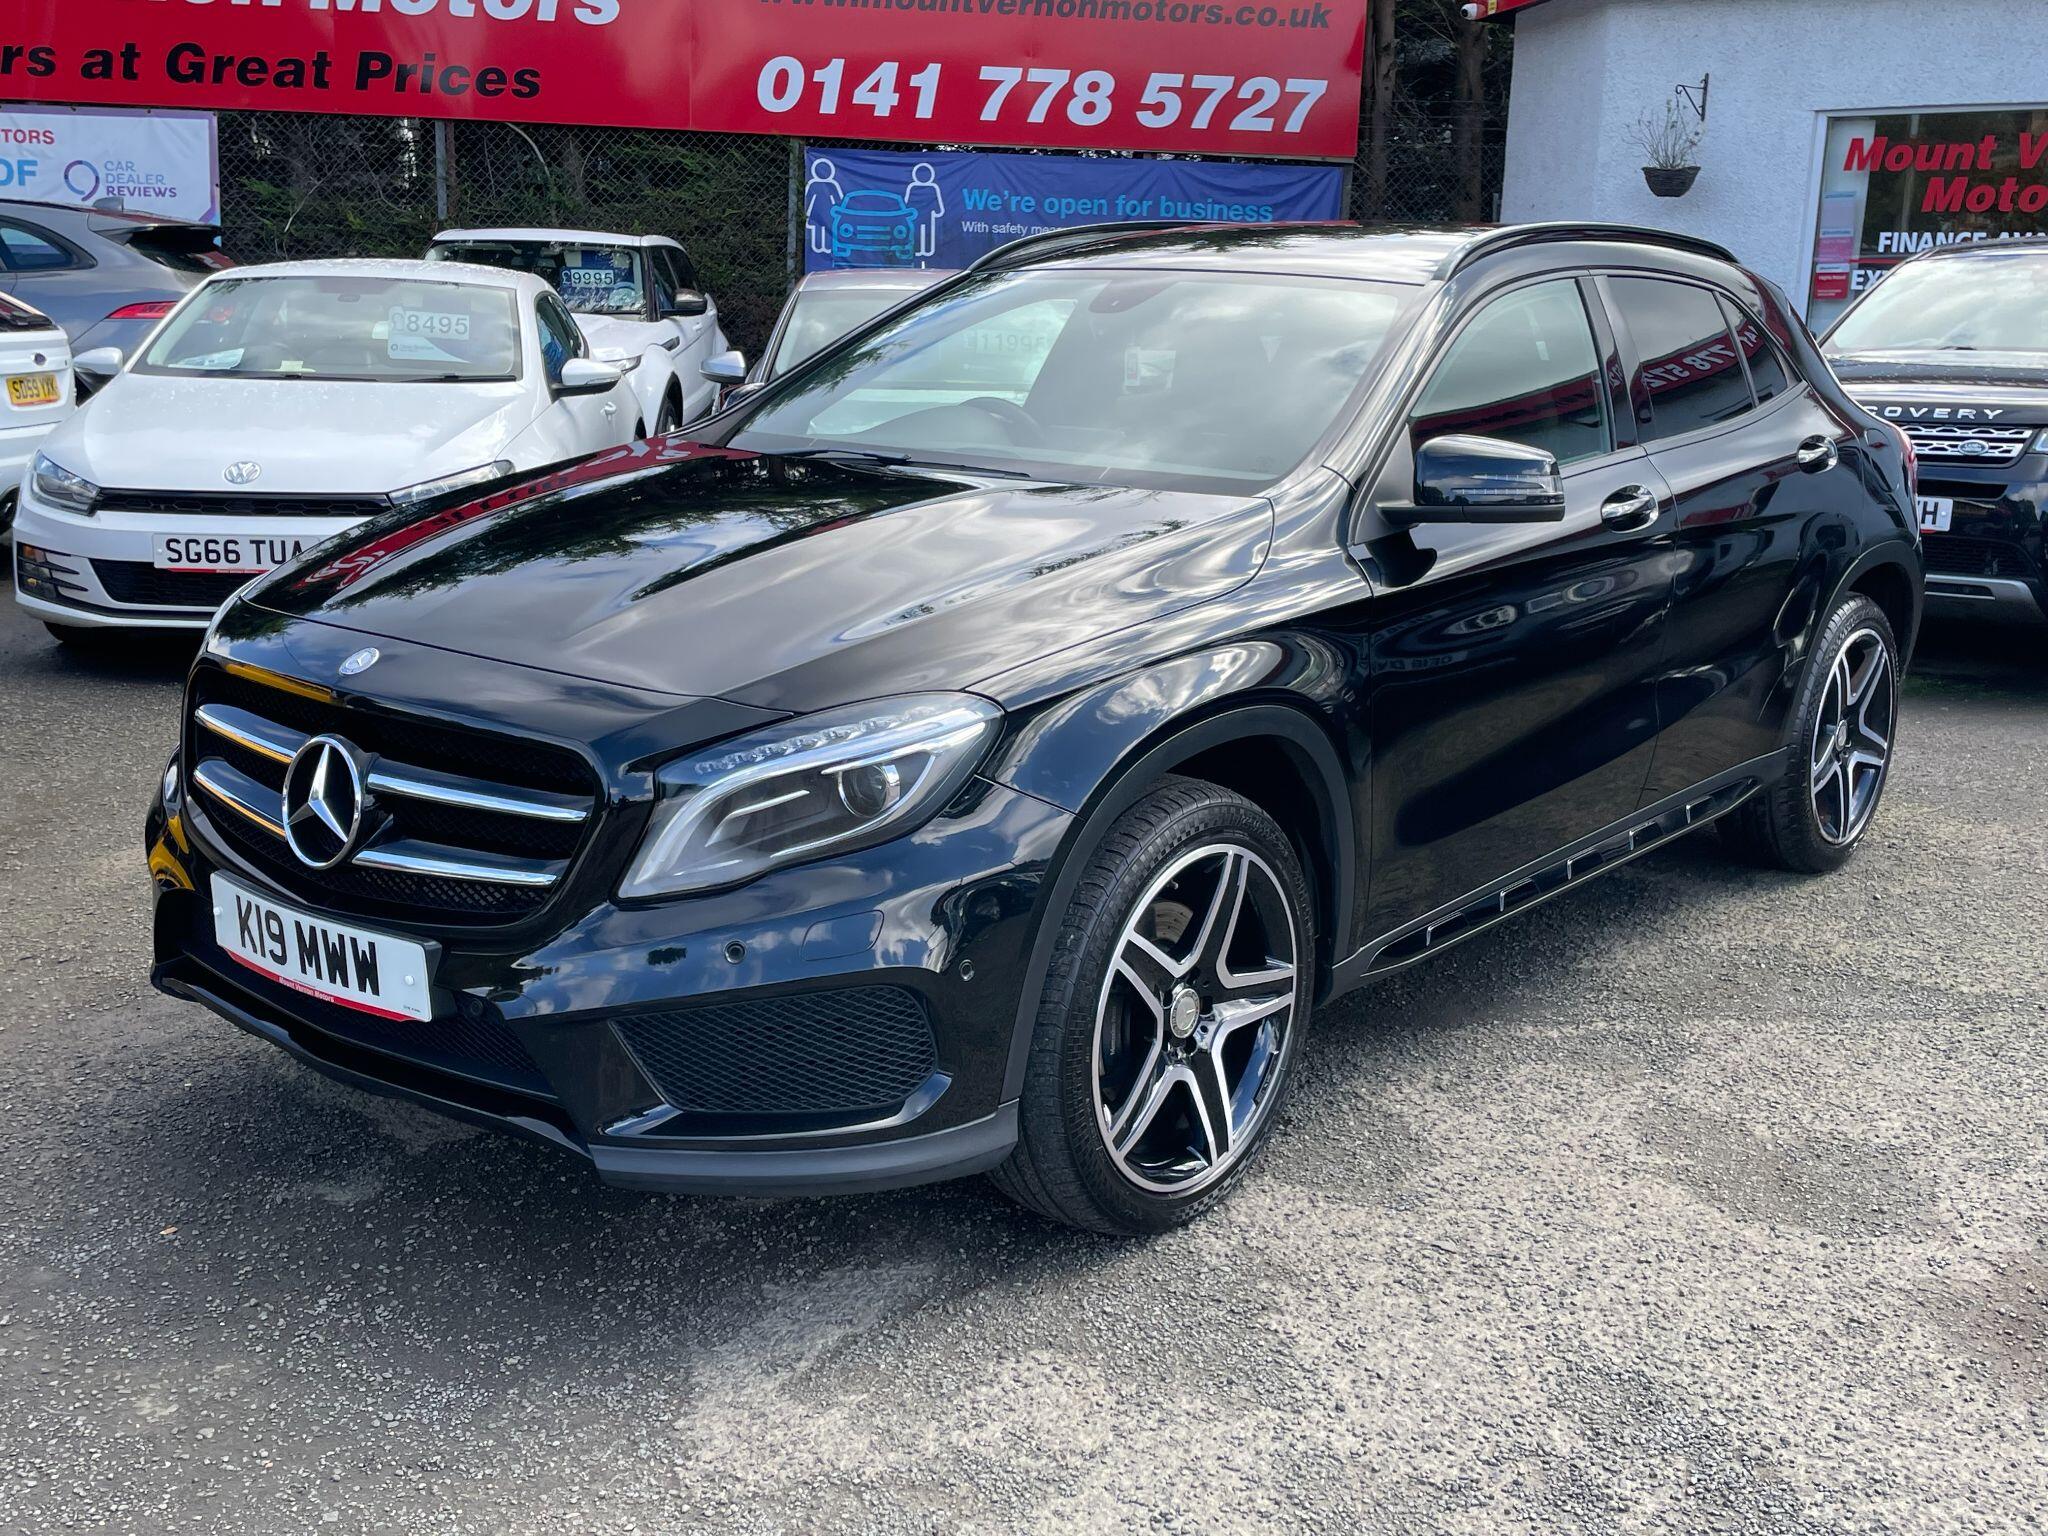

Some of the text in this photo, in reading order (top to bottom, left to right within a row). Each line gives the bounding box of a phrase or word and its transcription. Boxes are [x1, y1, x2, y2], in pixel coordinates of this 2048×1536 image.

[759, 0, 1332, 28] .ountvernonmotors.co.uk
[80, 42, 141, 80] at
[165, 42, 333, 90] Great
[355, 51, 541, 99] Prices
[757, 55, 1329, 133] 0141 778 5727
[1843, 132, 2048, 171] Mount V
[104, 160, 136, 172] CAR
[105, 173, 166, 185] DEALER
[106, 185, 178, 198] REVIEWS
[1043, 195, 1108, 219] open
[1114, 194, 1153, 218] for
[1159, 195, 1274, 223] business
[961, 220, 989, 233] With
[991, 222, 1029, 237] safety
[561, 271, 613, 285] £9995
[165, 538, 241, 564] SG66
[235, 894, 381, 997] K19 MWW
